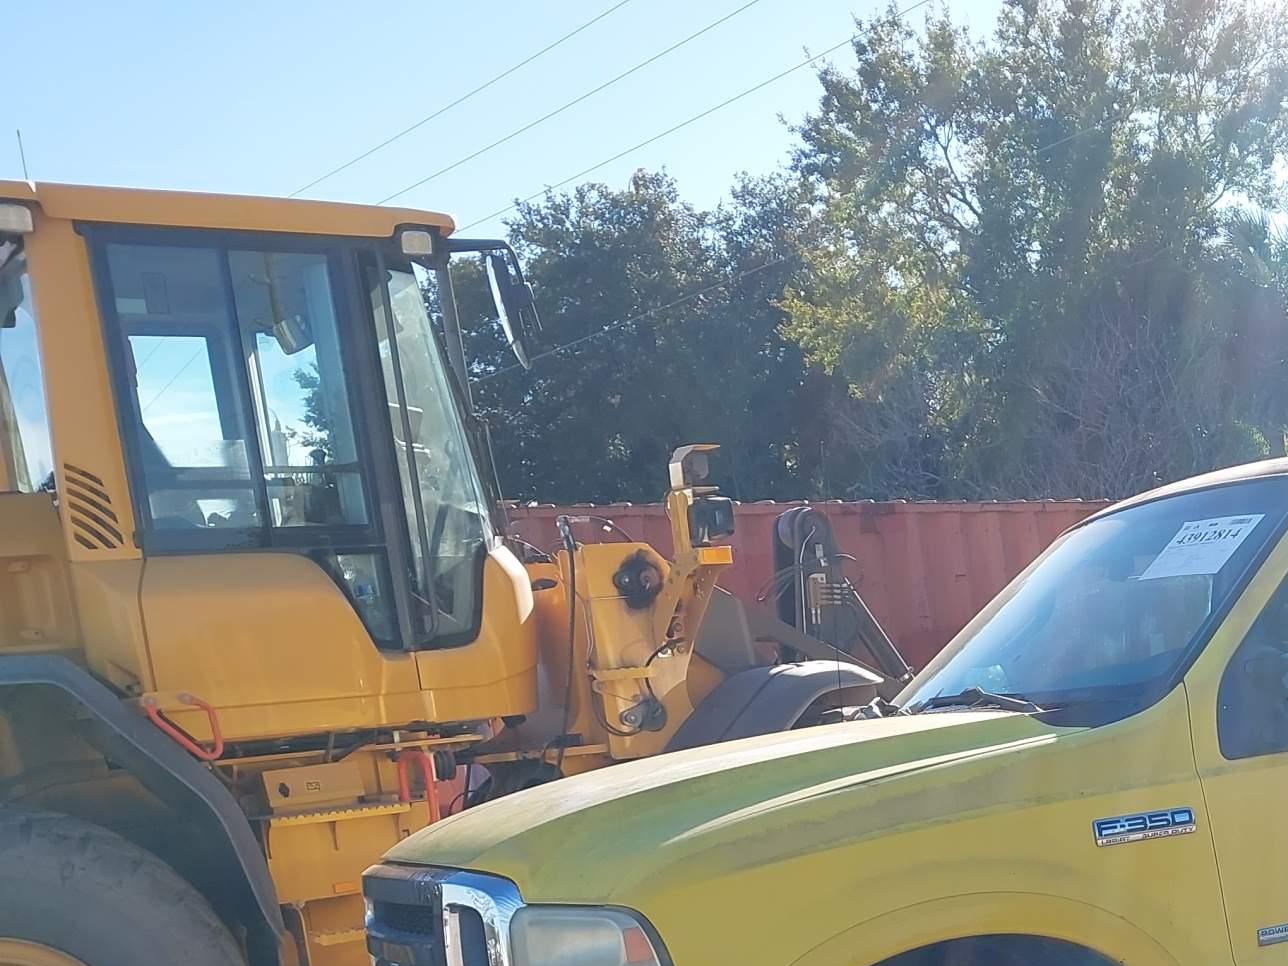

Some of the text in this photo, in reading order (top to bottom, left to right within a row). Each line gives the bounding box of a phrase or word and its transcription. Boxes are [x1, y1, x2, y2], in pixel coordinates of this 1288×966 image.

[1176, 528, 1242, 544] 43912814
[1096, 809, 1194, 838] F-350
[1172, 826, 1195, 836] DUTY
